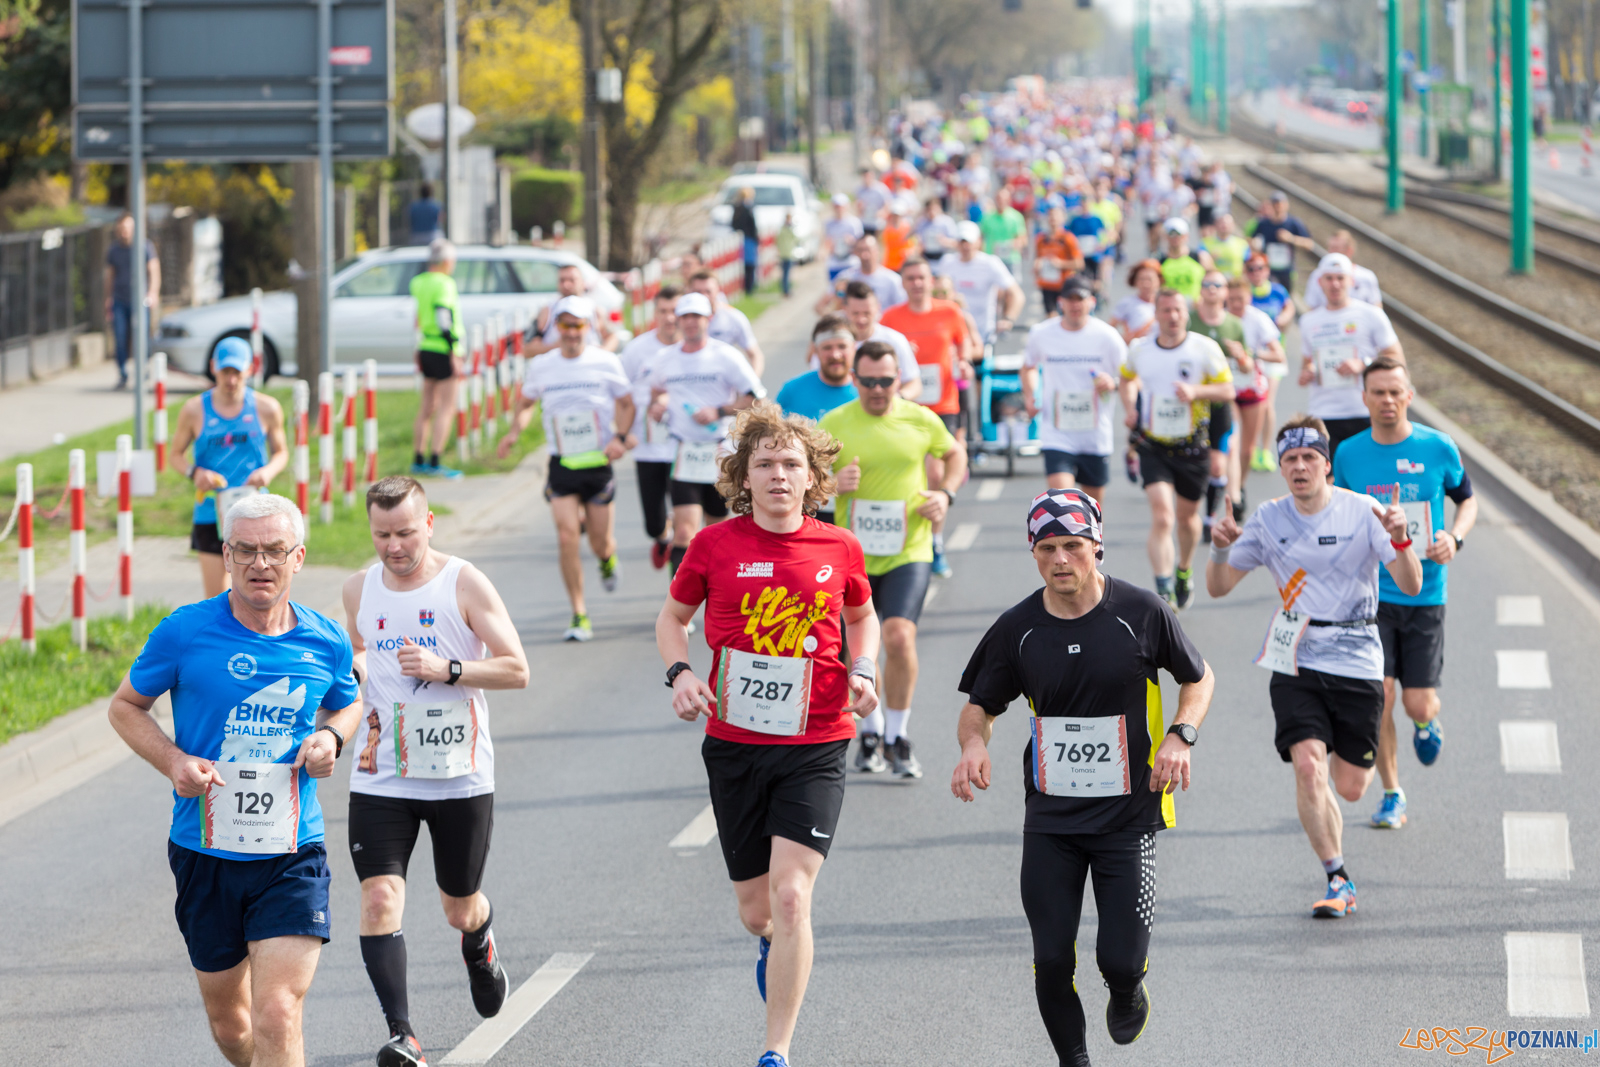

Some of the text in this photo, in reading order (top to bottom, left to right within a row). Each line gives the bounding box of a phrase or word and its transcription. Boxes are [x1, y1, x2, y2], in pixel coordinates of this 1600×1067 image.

[857, 516, 903, 532] 10558
[740, 676, 793, 702] 7287
[235, 702, 296, 725] BIKE
[756, 702, 771, 711] Piotr
[415, 725, 465, 747] 1403
[249, 748, 272, 758] 2016
[1054, 742, 1111, 763] 7692
[234, 791, 274, 815] 129
[232, 818, 275, 827] Włodzimierz
